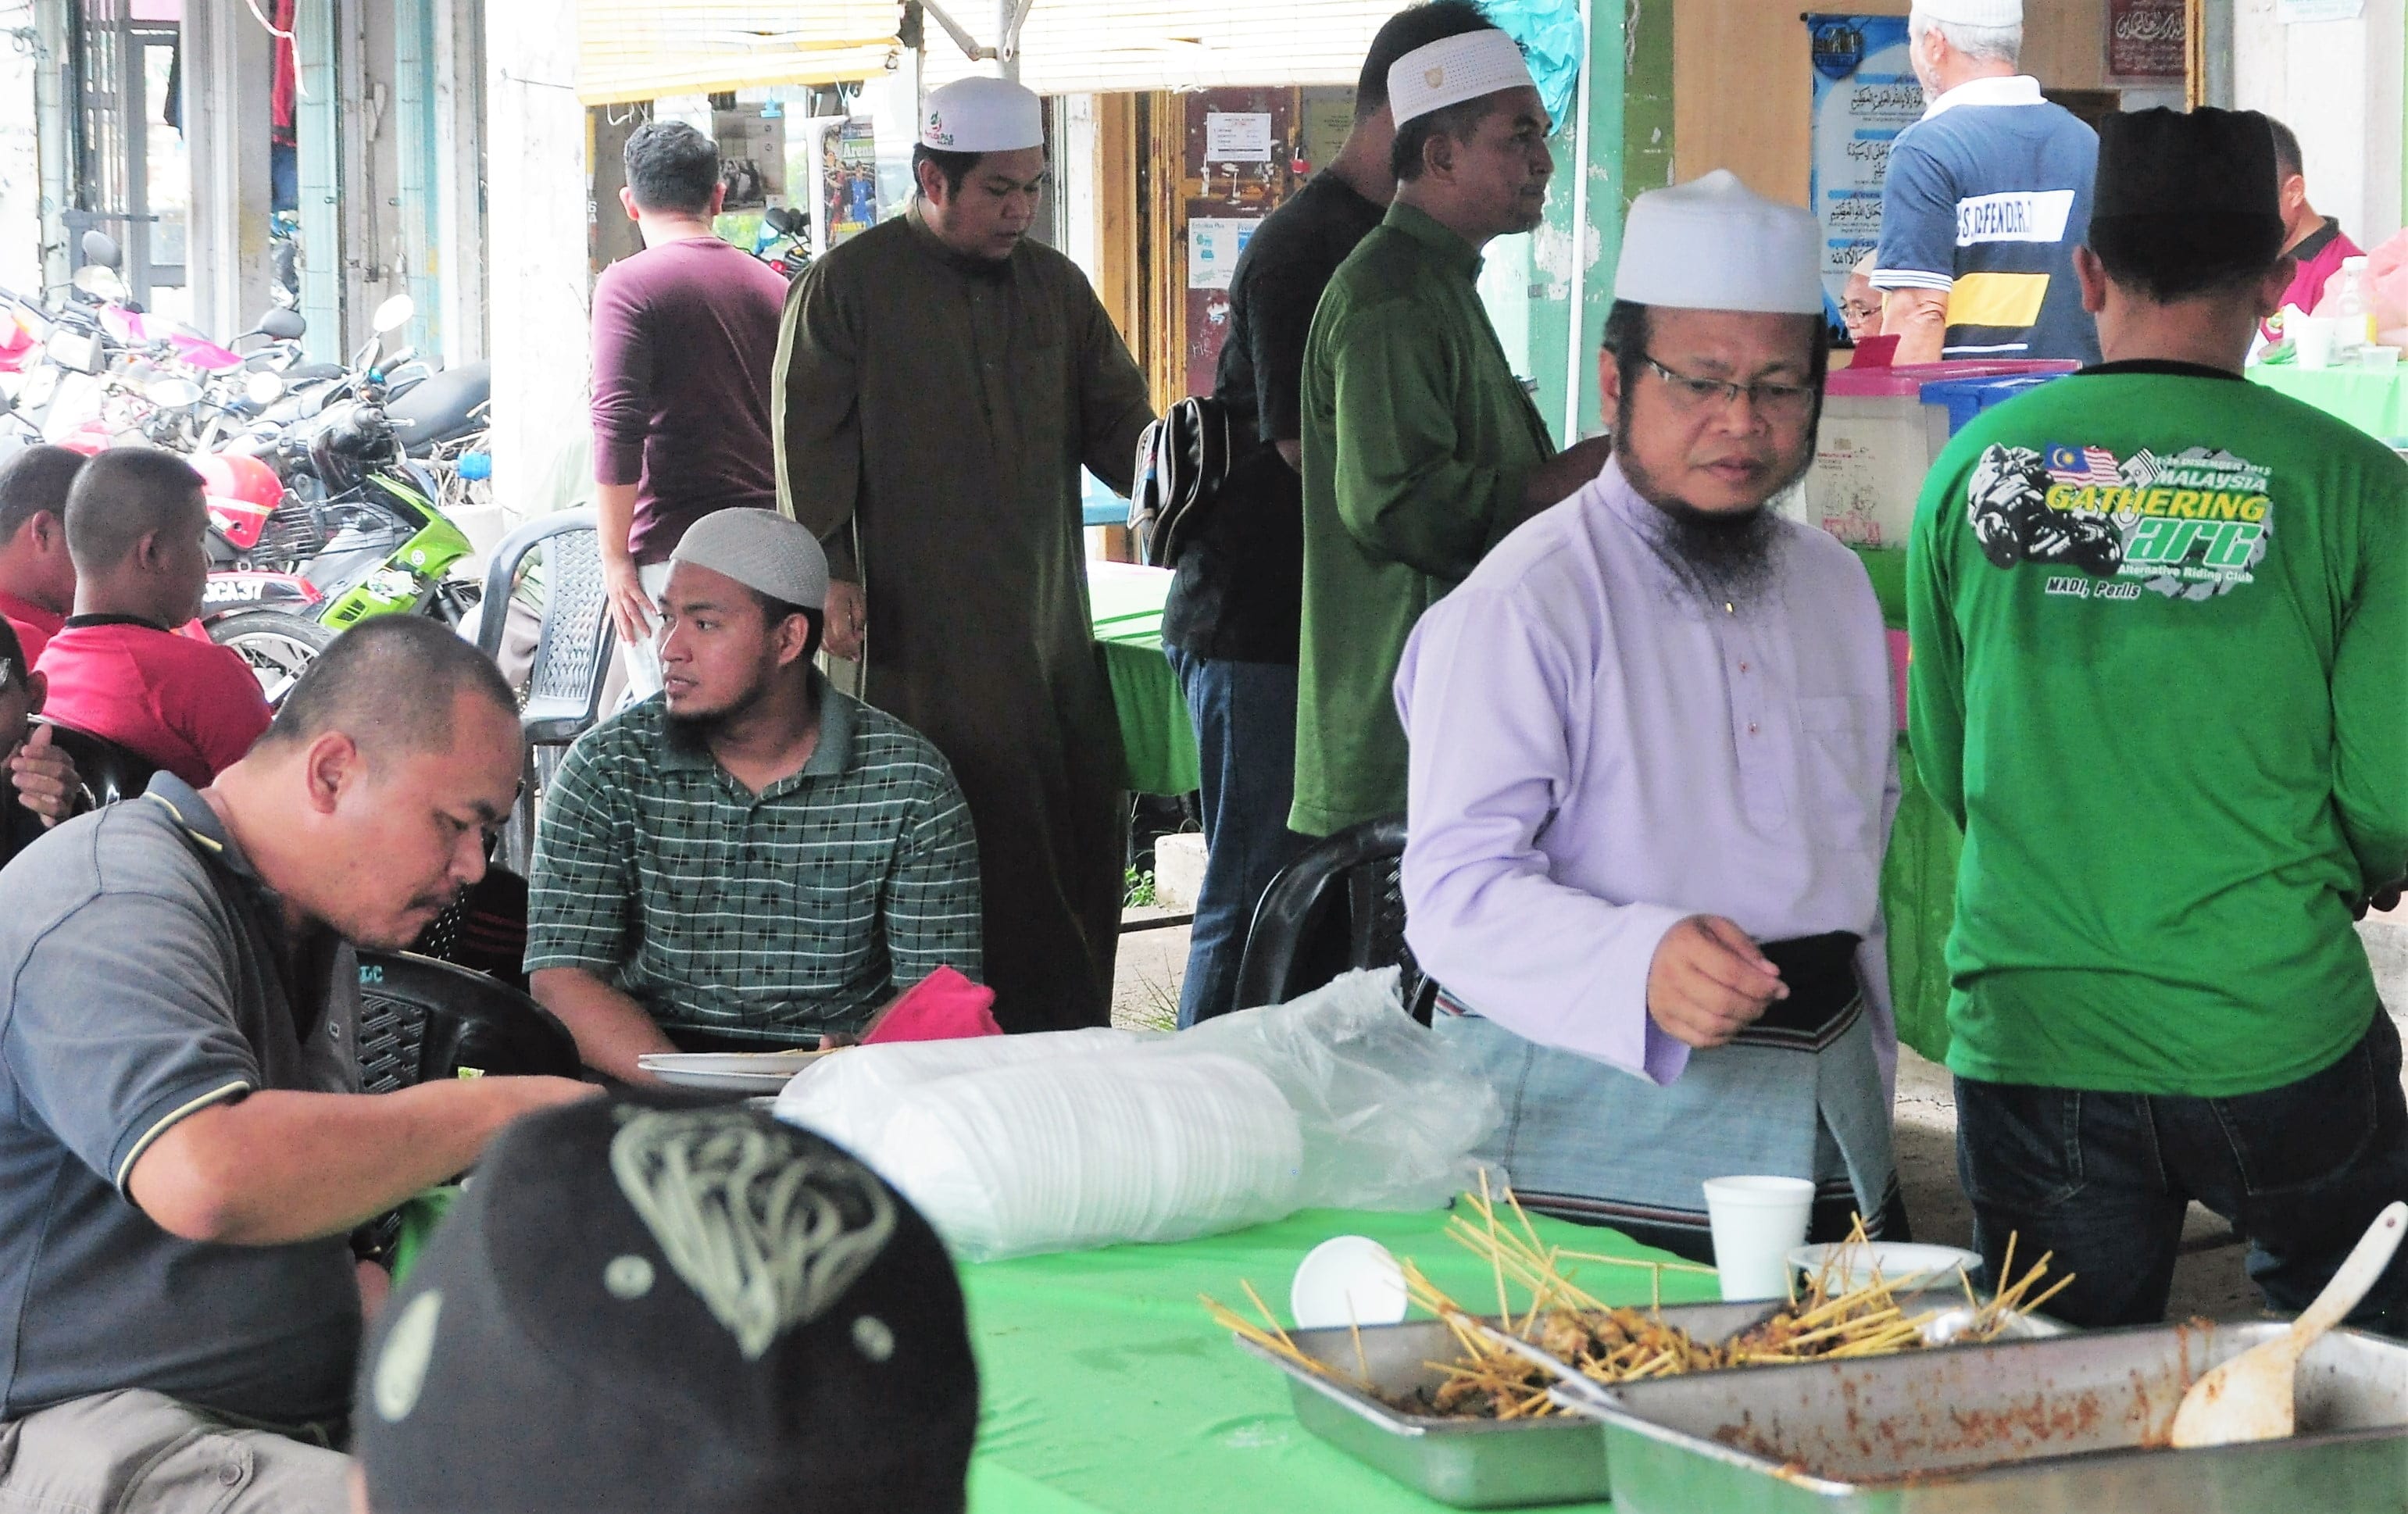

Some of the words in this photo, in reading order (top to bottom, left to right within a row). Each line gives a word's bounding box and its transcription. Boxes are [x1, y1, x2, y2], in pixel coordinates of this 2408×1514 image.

[2153, 470, 2267, 491] MALAYSIA
[2045, 484, 2267, 522] GATHERING
[2123, 517, 2264, 567] arc
[2117, 563, 2180, 577] Alternative
[2183, 567, 2222, 582] Riding
[2225, 570, 2254, 583] Club
[2094, 580, 2142, 600] Perlis
